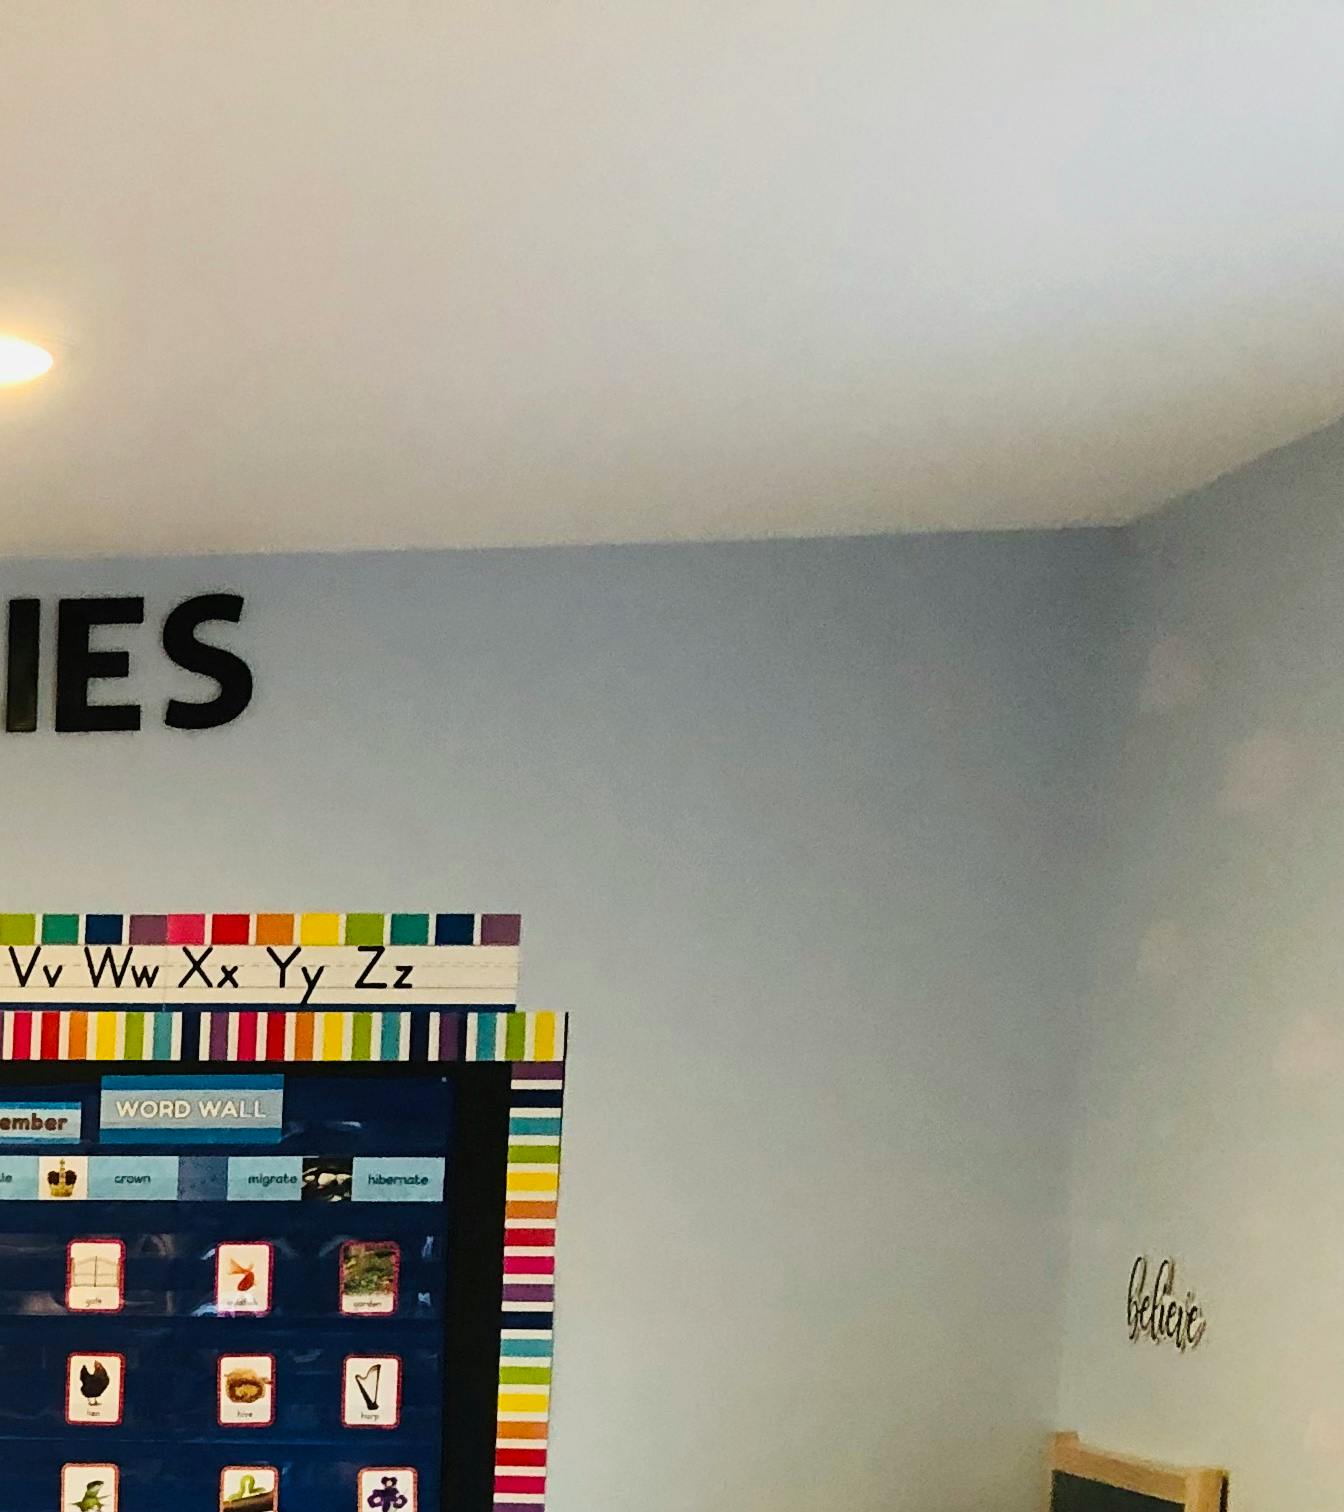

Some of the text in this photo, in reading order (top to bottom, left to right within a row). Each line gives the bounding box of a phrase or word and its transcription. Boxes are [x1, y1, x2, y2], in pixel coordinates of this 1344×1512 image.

[8, 945, 63, 988] Vv
[84, 945, 159, 988] Ww
[178, 946, 239, 988] Xx
[266, 946, 324, 1005] Yy
[355, 945, 413, 989] Zz
[115, 1100, 266, 1119] WORD WALL
[113, 1174, 151, 1185] crown
[248, 1173, 298, 1188] migrate
[367, 1173, 429, 1186] hibernate
[1127, 1256, 1206, 1350] believe
